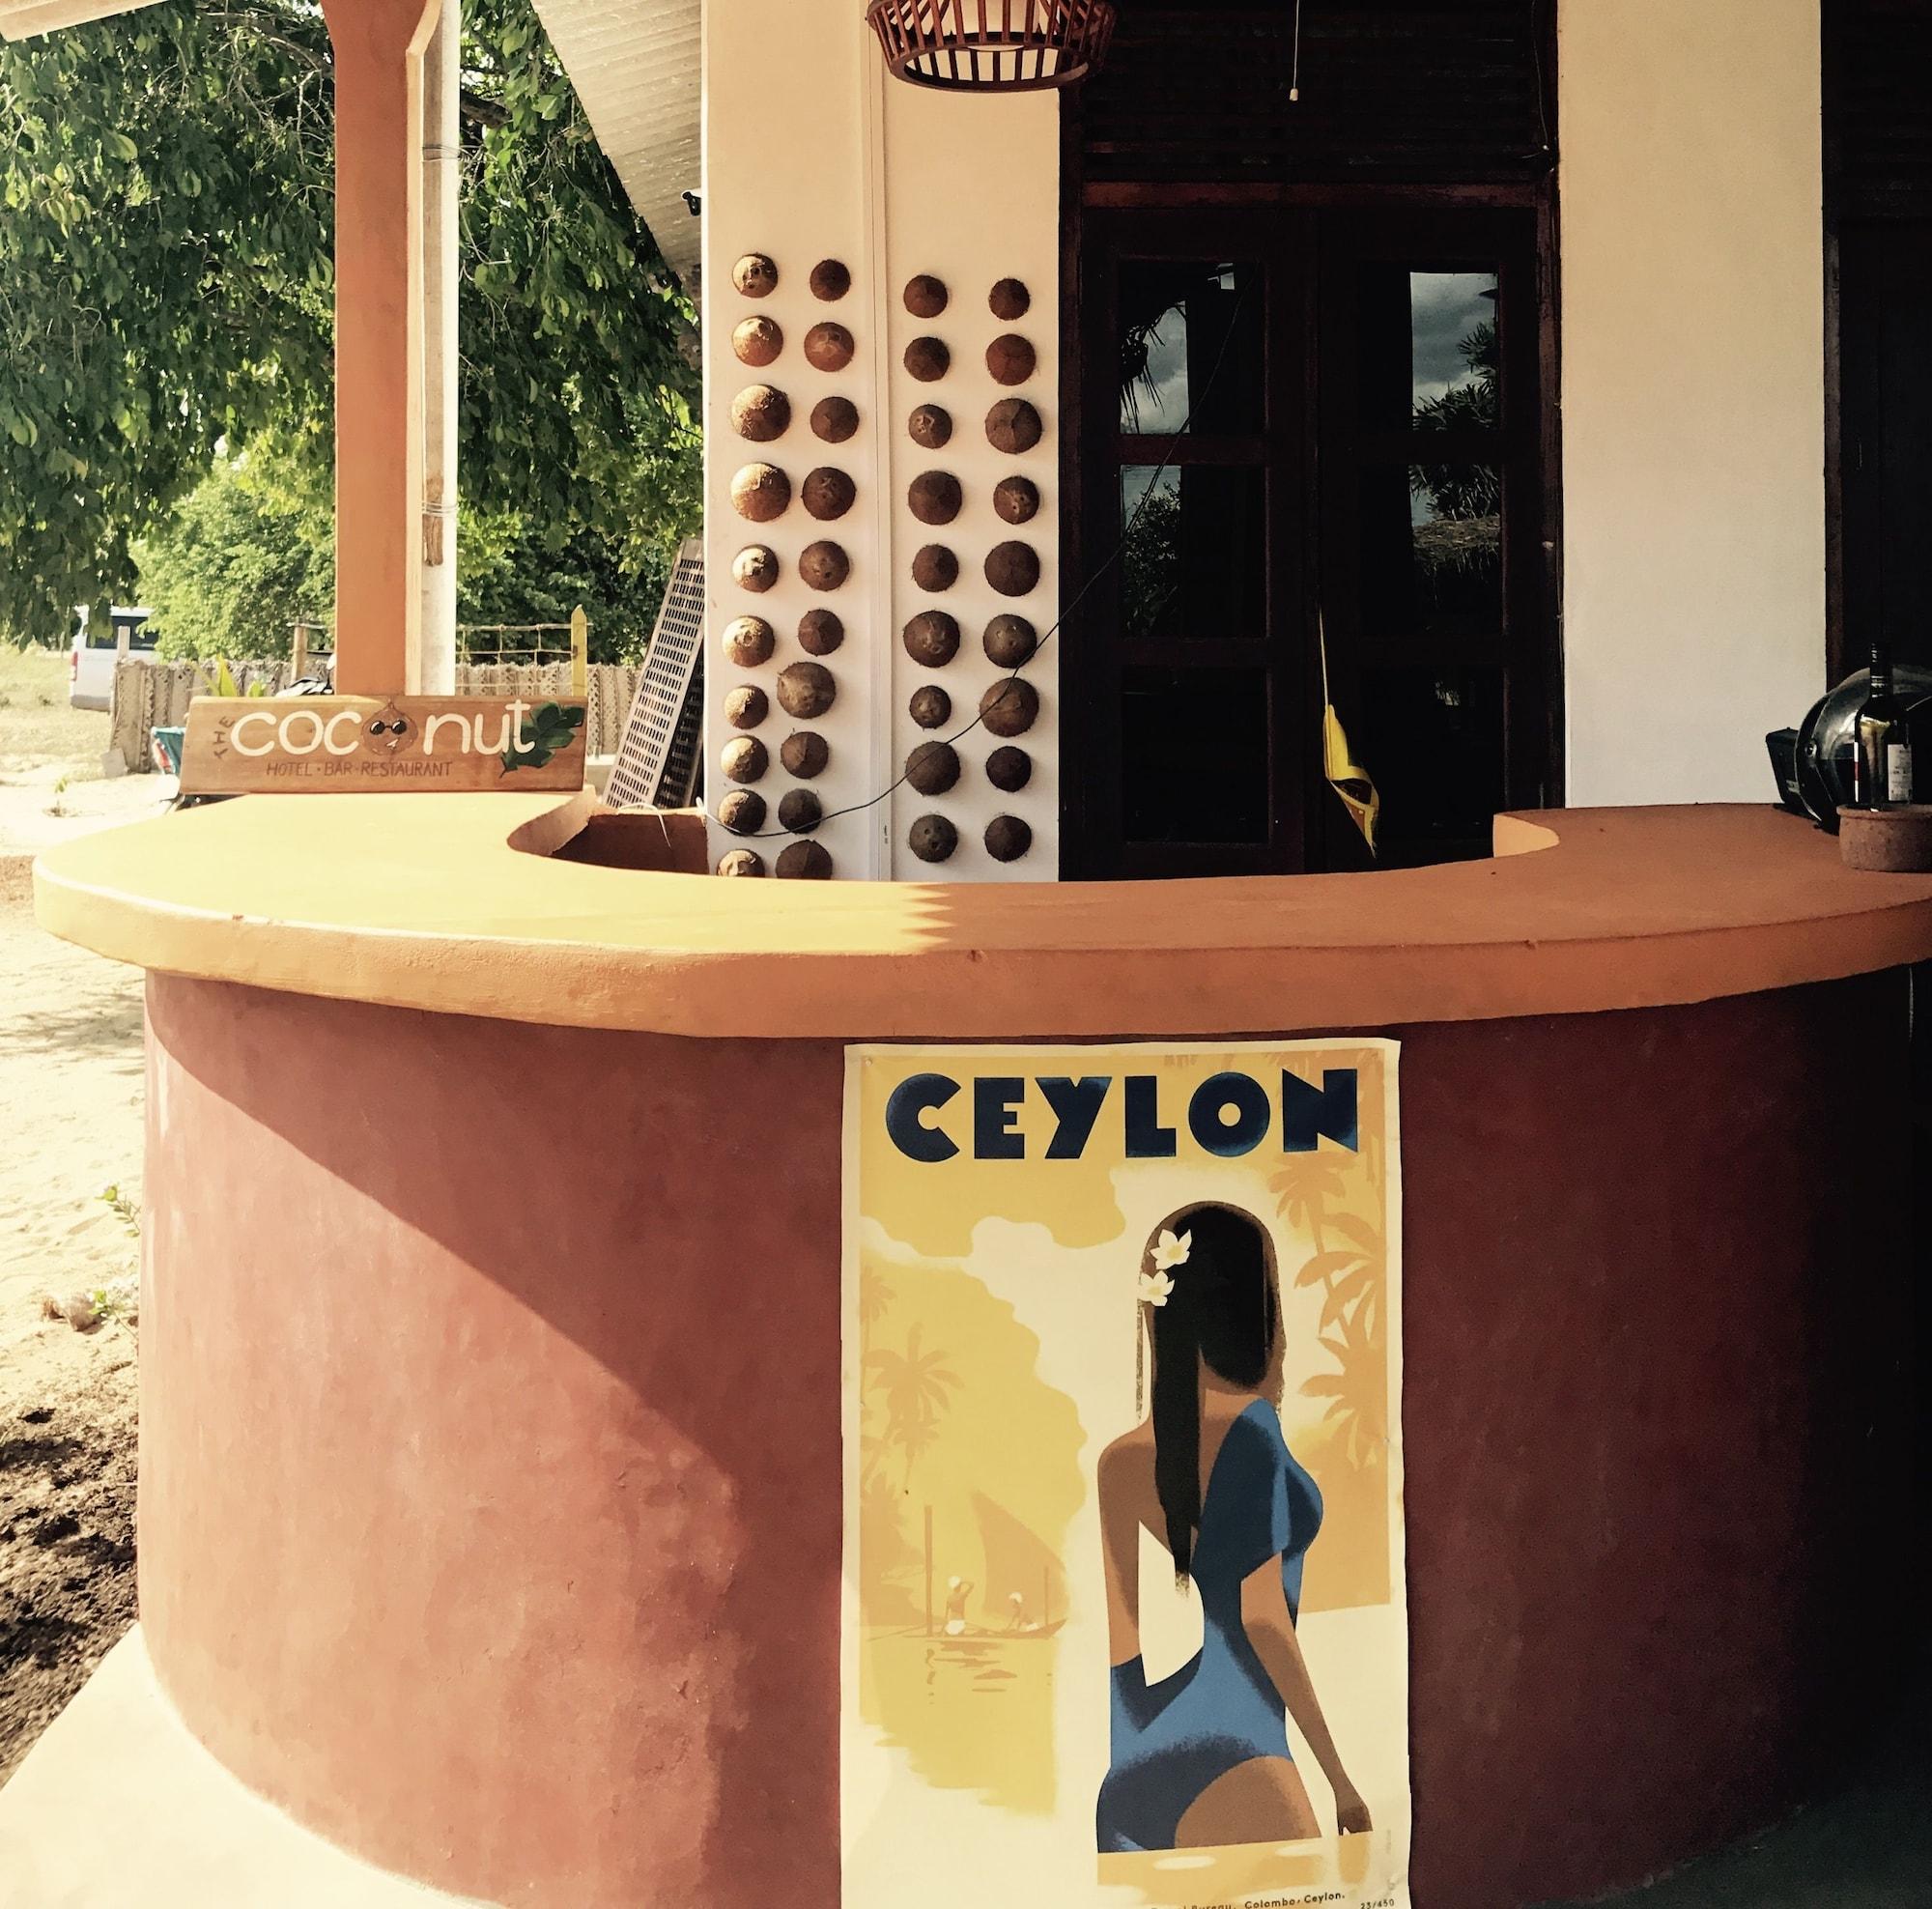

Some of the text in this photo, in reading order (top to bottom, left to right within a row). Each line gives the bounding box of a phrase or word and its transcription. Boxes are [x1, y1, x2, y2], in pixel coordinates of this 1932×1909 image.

[266, 760, 453, 777] HOTEL BAR RESTAURANT
[886, 1068, 1358, 1162] CEYLON
